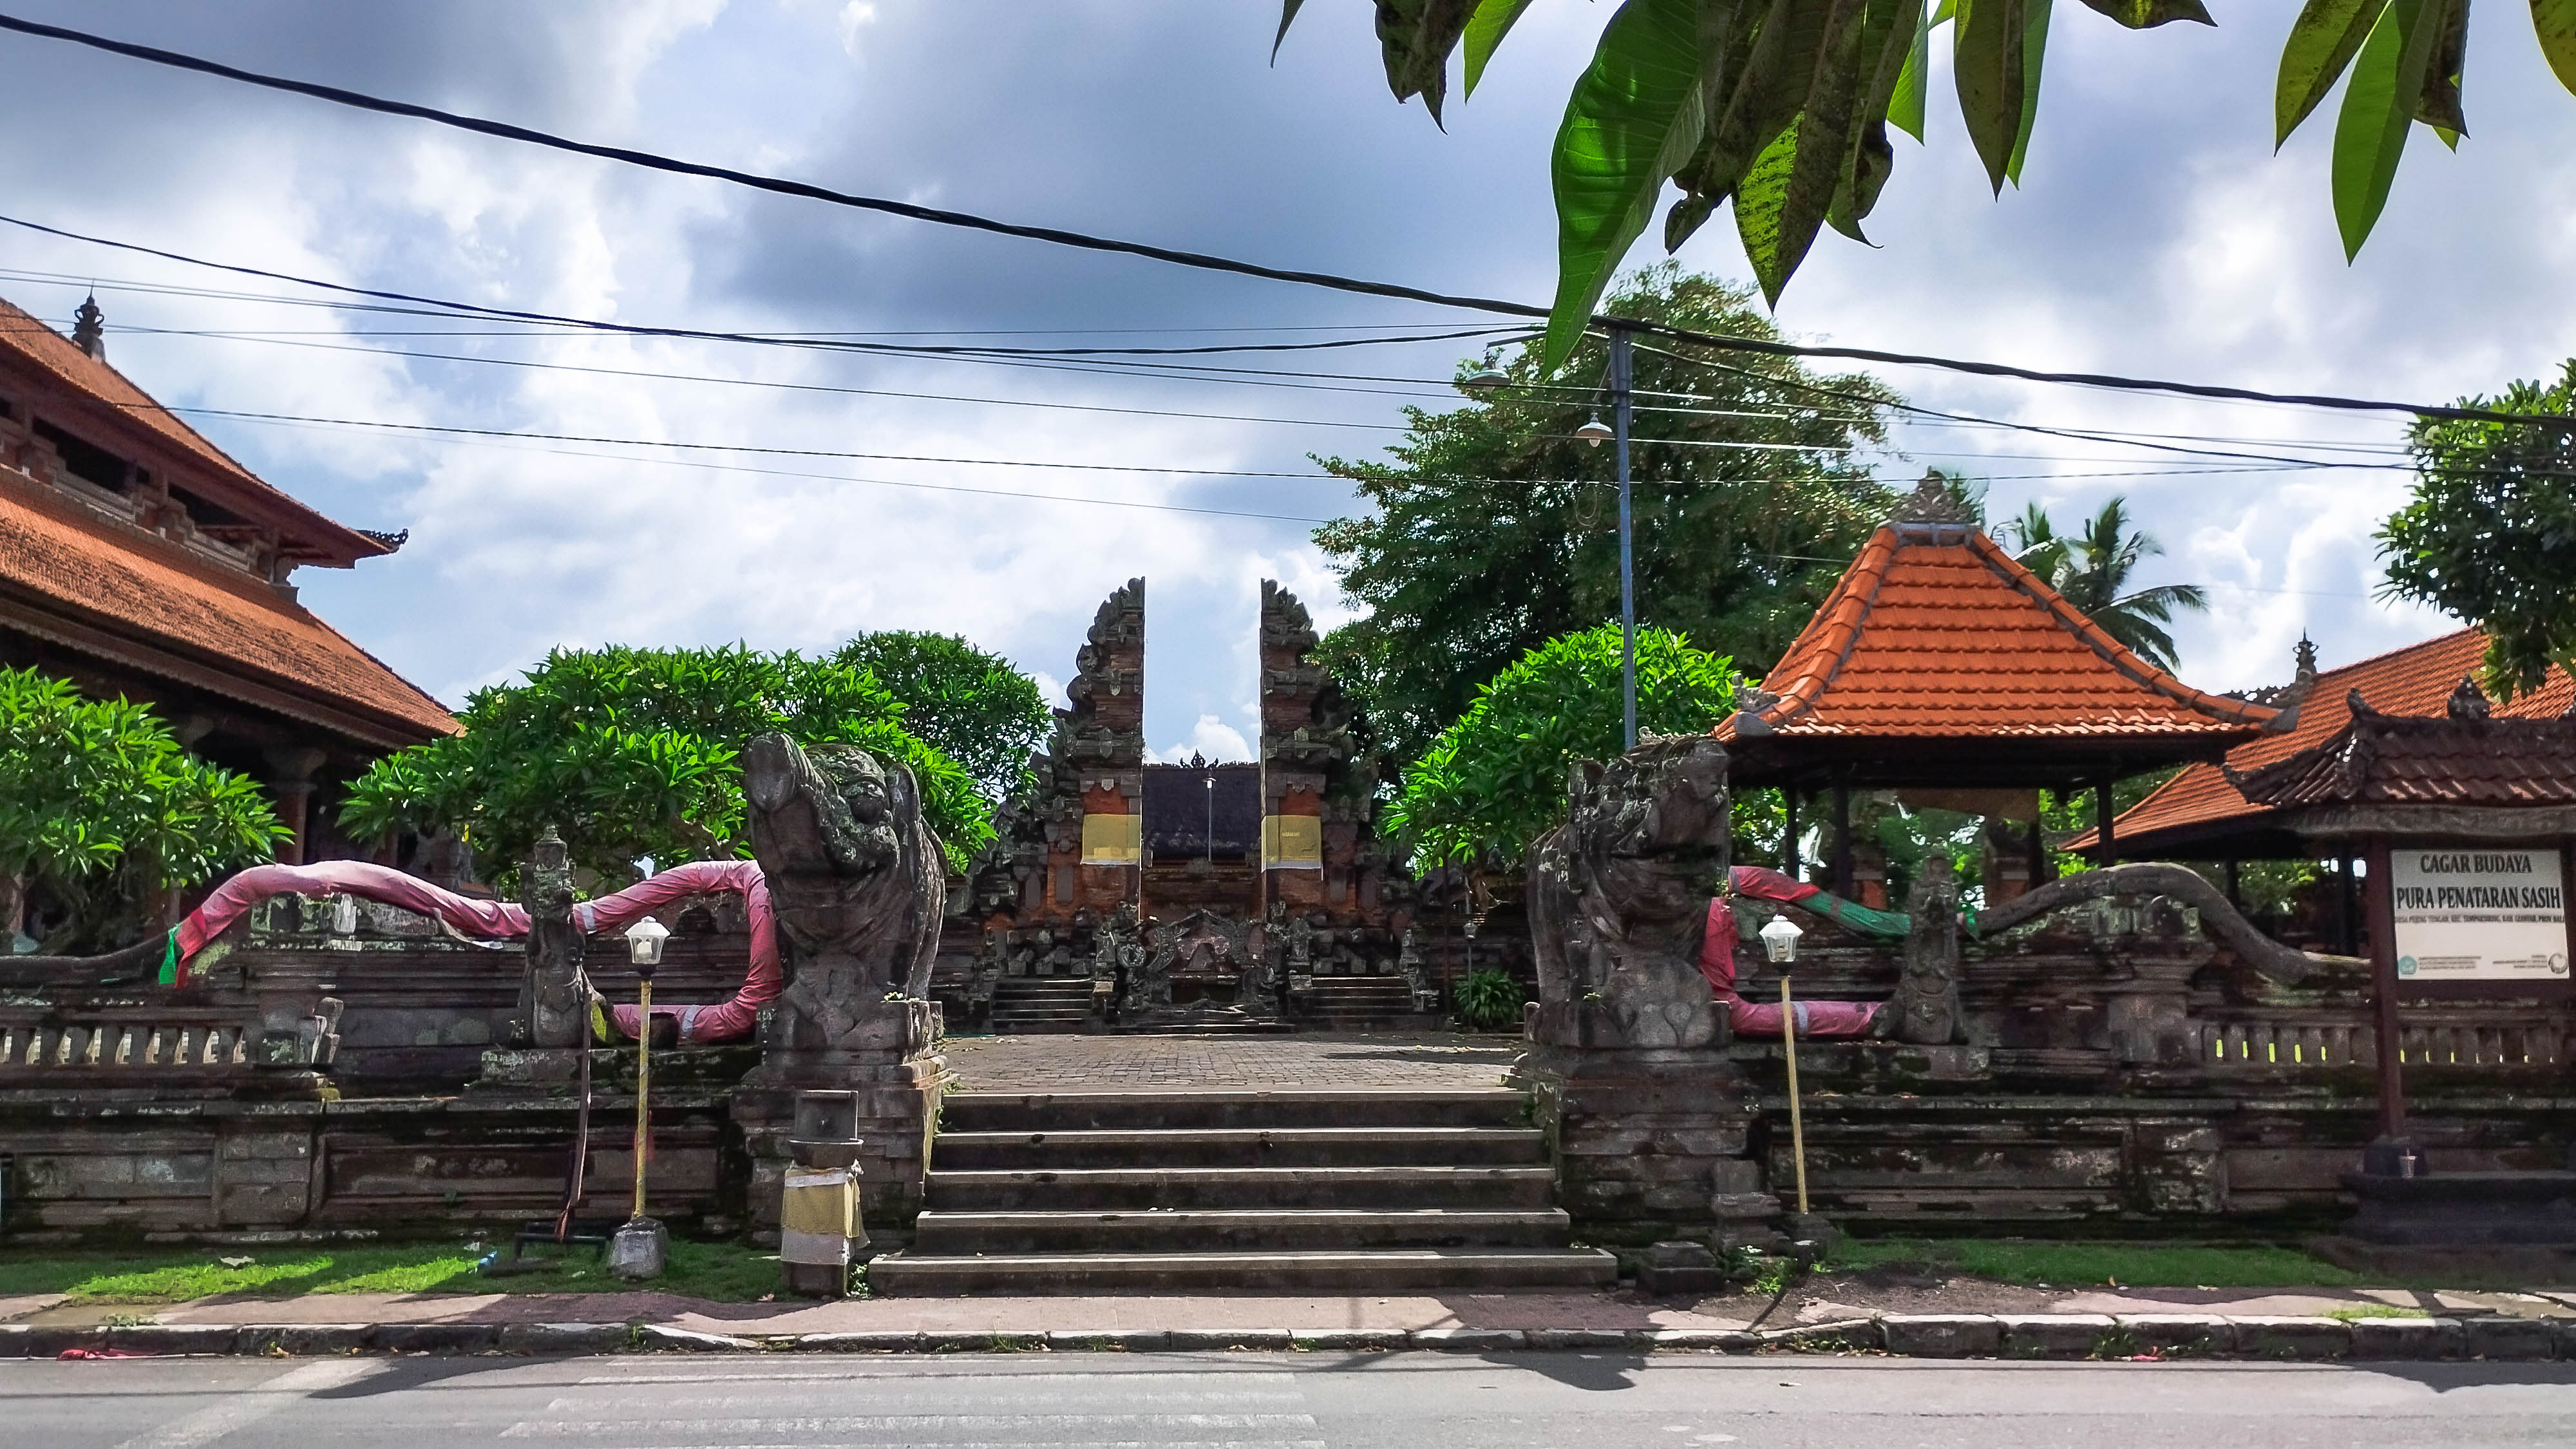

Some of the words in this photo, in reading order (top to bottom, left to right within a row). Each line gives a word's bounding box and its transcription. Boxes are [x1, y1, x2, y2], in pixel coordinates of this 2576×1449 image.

[2420, 855, 2470, 873] CAGAR
[2475, 855, 2532, 873] BUDAYA
[2397, 887, 2434, 909] PURA
[2438, 887, 2519, 909] PENATARAN
[2521, 887, 2561, 909] SASIH
